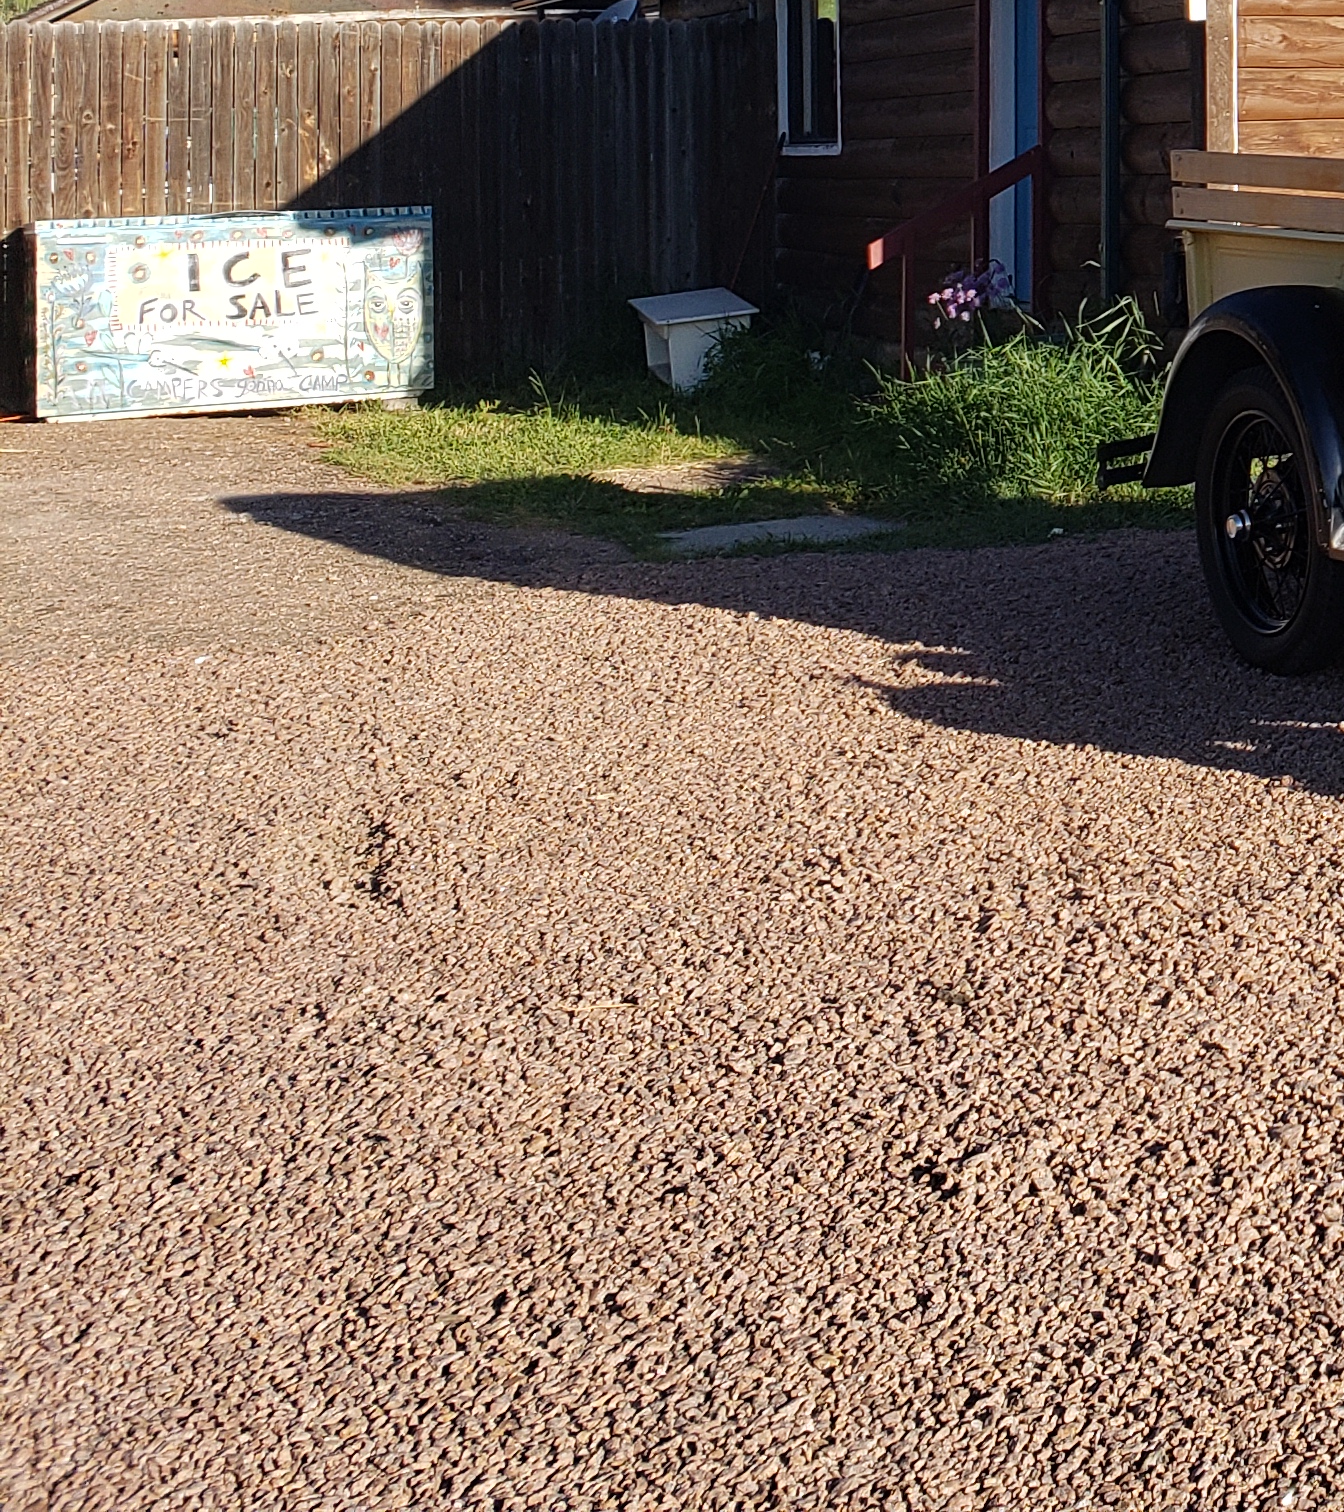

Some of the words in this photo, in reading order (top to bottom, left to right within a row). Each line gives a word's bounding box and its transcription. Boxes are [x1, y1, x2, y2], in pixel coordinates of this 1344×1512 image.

[188, 248, 312, 291] ICE
[139, 297, 206, 324] FOR
[226, 289, 319, 320] SALE
[126, 377, 224, 400] CAMPERS
[299, 373, 349, 392] CAMP
